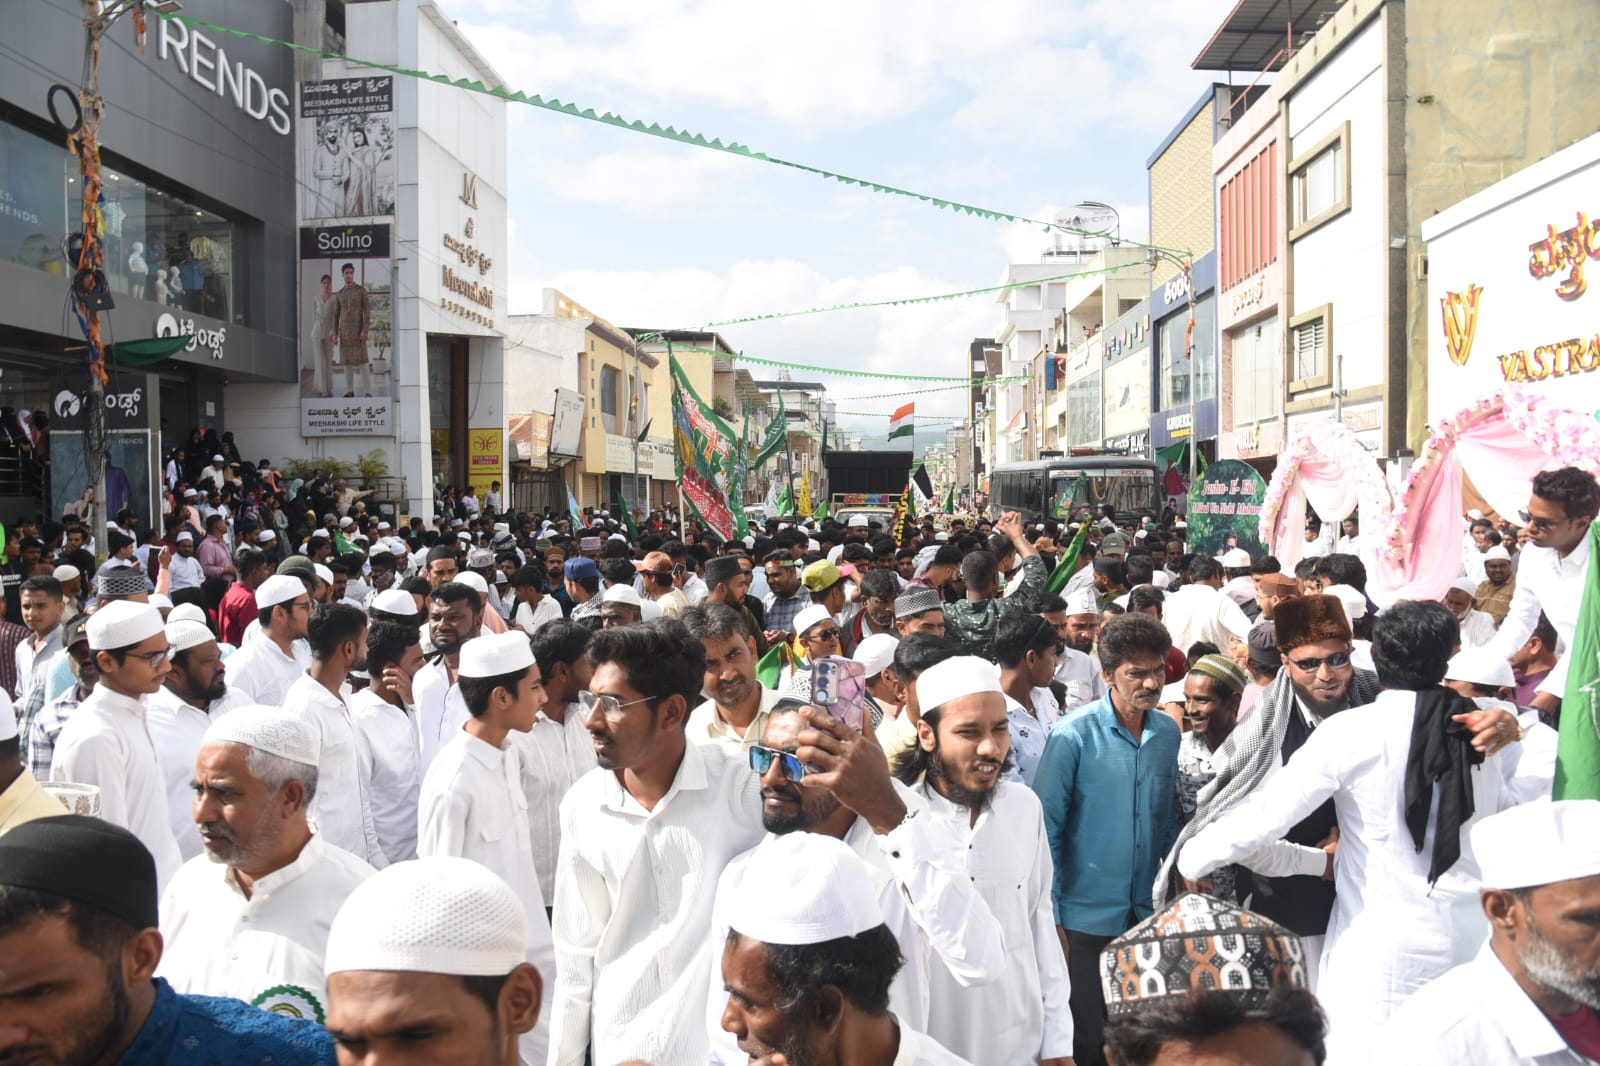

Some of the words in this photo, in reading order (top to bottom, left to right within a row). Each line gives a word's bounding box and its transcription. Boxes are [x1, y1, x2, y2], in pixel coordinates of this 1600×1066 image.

[303, 99, 347, 108] MEENAKSHI
[348, 97, 364, 105] LIFE
[365, 94, 389, 103] STYLE
[318, 229, 373, 249] Solino
[442, 264, 493, 310] Meenakshi
[1241, 479, 1257, 495] Eid
